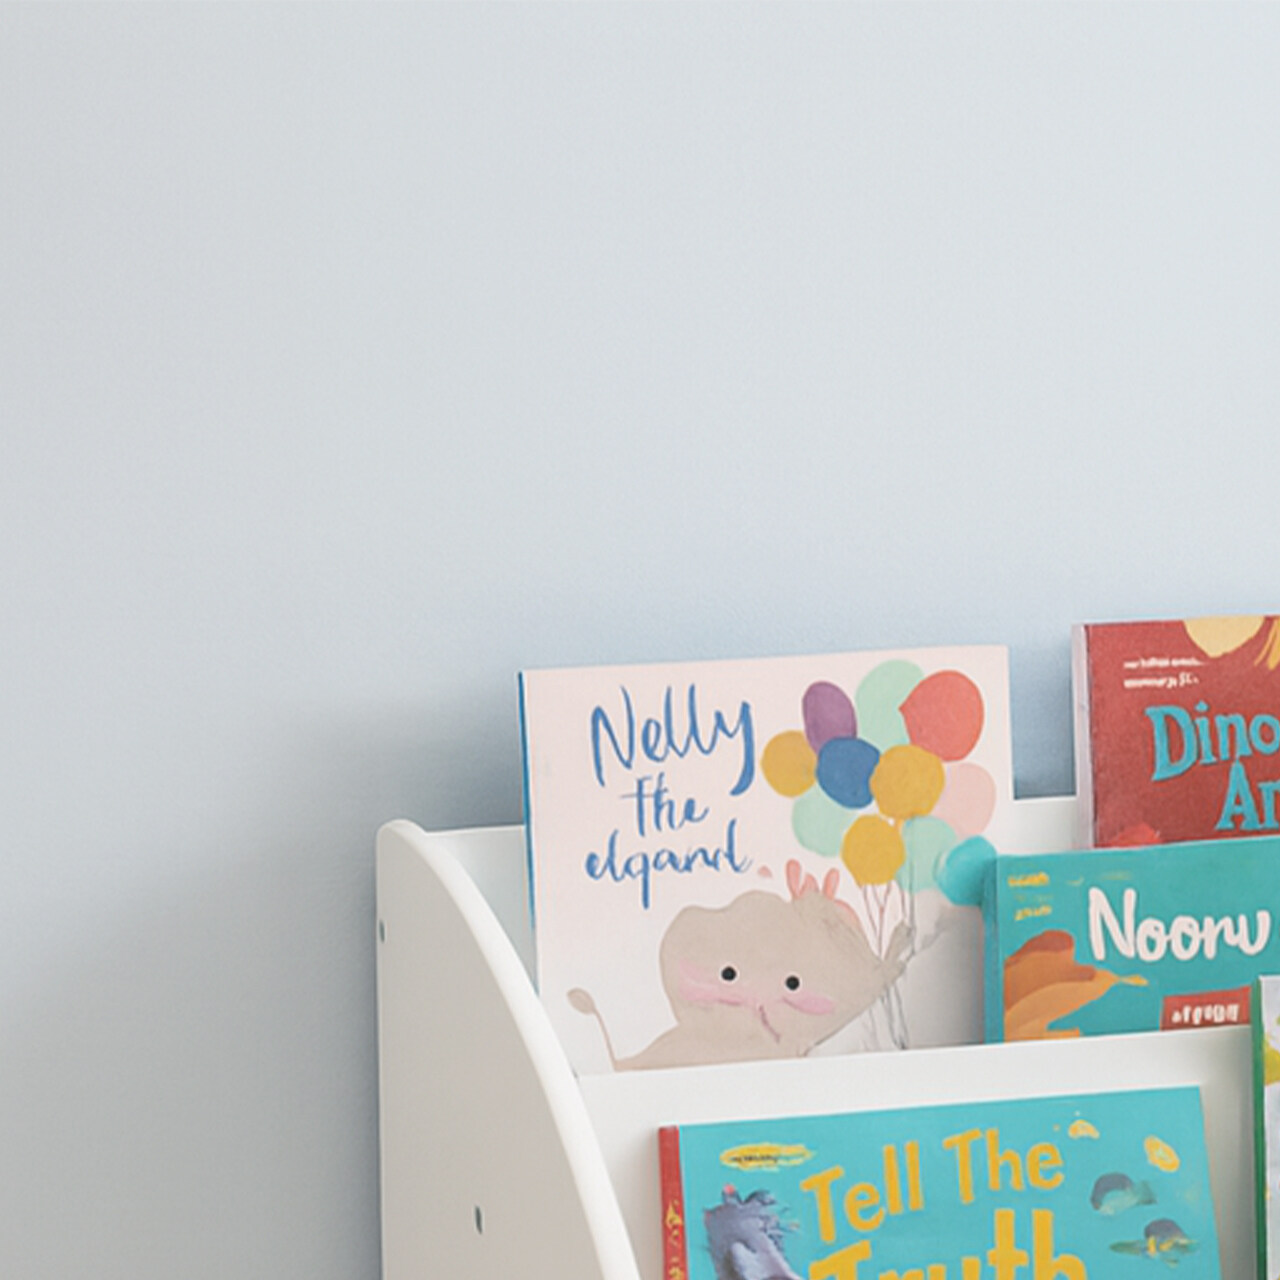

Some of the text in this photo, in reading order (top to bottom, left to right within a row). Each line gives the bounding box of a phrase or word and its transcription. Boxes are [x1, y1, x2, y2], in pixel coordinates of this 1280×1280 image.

[590, 683, 756, 796] Nelly
[800, 1127, 1065, 1244] Tell The
